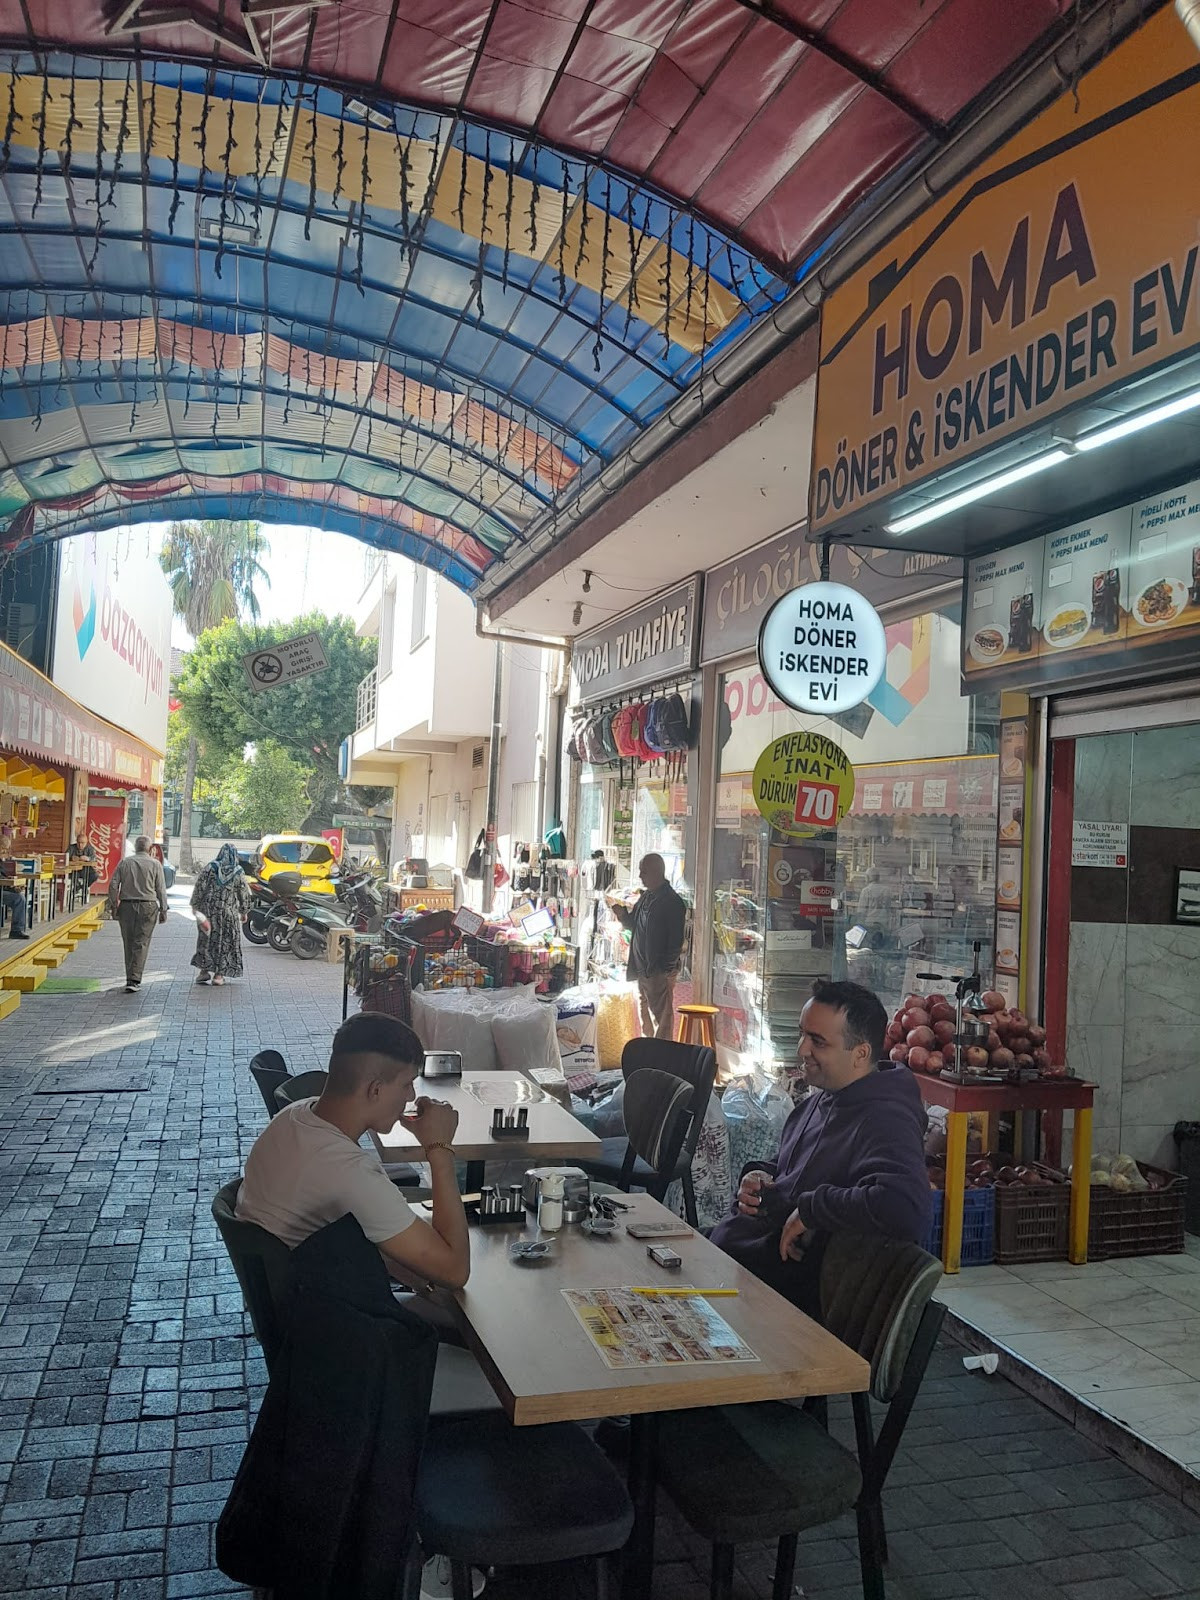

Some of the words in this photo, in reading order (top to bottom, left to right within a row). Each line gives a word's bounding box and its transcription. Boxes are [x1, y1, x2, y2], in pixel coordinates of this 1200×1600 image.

[872, 182, 1096, 416] HOMA
[816, 426, 897, 520] DÖNER
[904, 410, 925, 472] &
[1164, 495, 1187, 509] KÖFTE
[1168, 510, 1186, 523] MAX
[1070, 528, 1091, 542] EKMEK
[1074, 542, 1088, 553] MAX
[995, 568, 1007, 579] MAX
[799, 600, 854, 621] HOMA
[101, 560, 163, 705] bazaaryum
[794, 622, 857, 649] DÖNER
[277, 637, 314, 653] MOTORLU
[289, 647, 309, 659] ARAÇ
[575, 642, 610, 686] MODA
[616, 605, 688, 670] TUHAFİYE
[287, 660, 324, 677] YASAKTIR
[809, 677, 838, 701] EVİ
[773, 734, 848, 776] ENFLASYONA
[784, 755, 835, 780] İNAT
[760, 773, 797, 805] DÜRÜM
[801, 786, 835, 820] 70
[1102, 824, 1122, 832] UYARI
